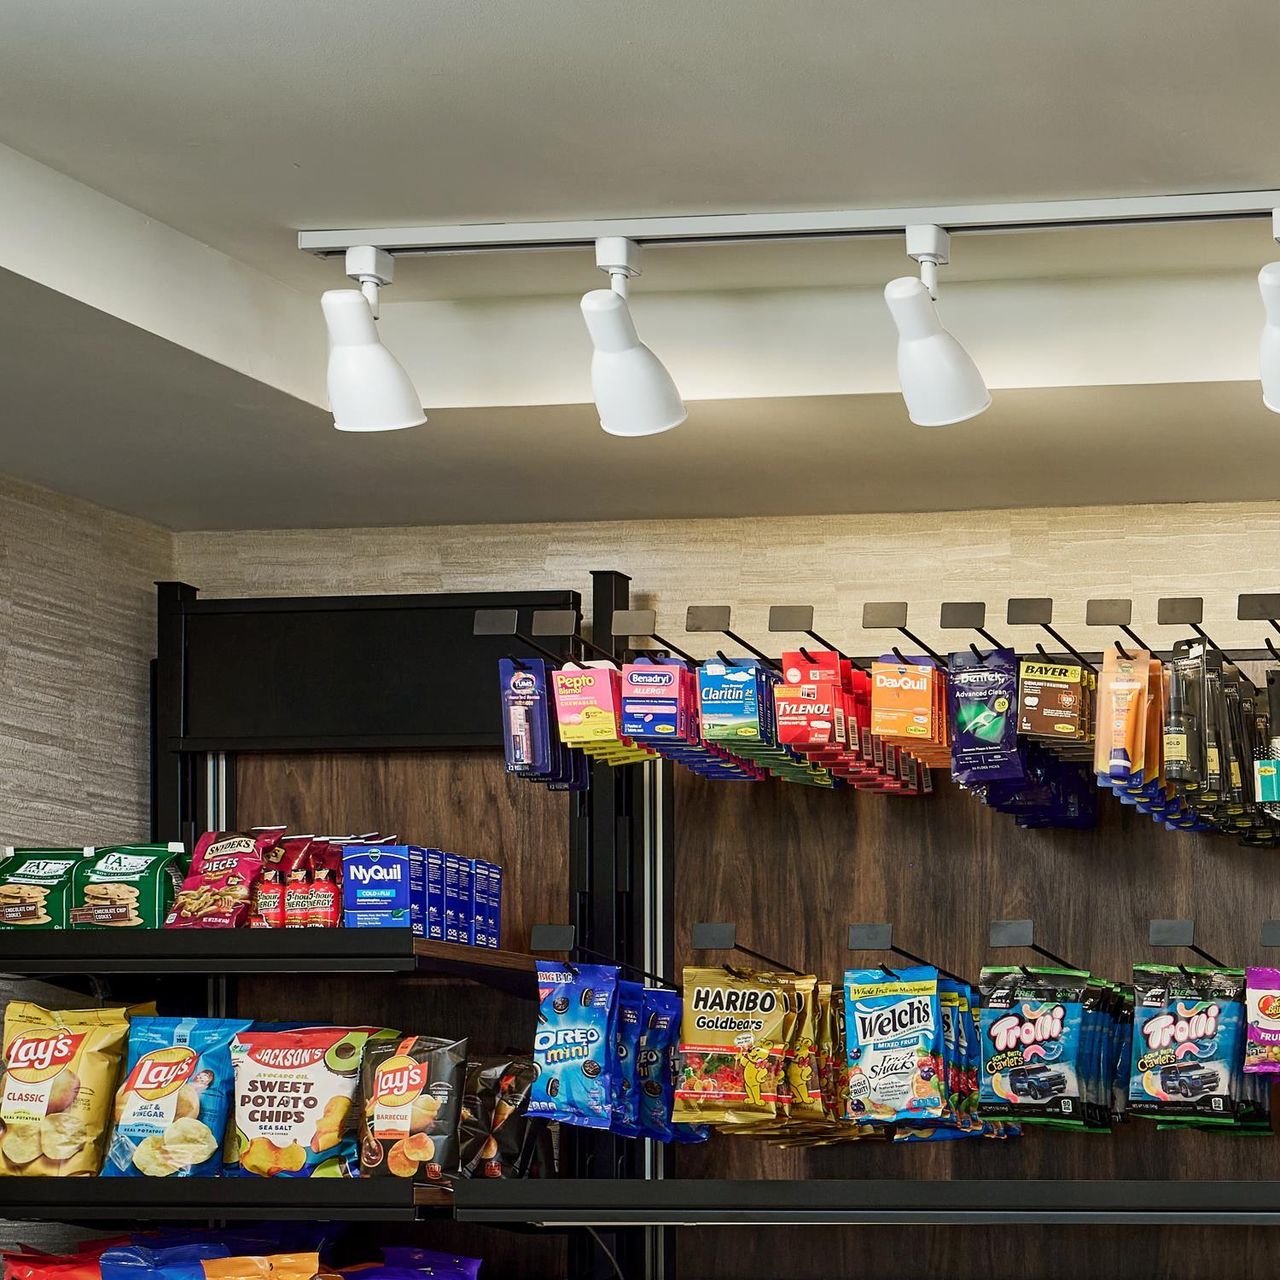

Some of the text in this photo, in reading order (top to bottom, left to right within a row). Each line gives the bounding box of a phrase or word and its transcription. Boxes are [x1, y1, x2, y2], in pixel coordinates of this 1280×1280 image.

[632, 674, 669, 683] Benadryl
[1025, 666, 1069, 677] BAYER
[557, 675, 594, 689] Pepto
[956, 689, 986, 698] Advanced
[778, 702, 830, 715] TYLENOL
[209, 839, 251, 855] SNYDER'S
[350, 865, 401, 884] NyQuil
[693, 989, 776, 1012] HARIBO
[696, 1016, 763, 1031] Goldbears
[859, 1001, 930, 1040] Welch's
[991, 1005, 1063, 1050] Trolli
[1146, 1004, 1219, 1050] Trolli
[535, 1029, 599, 1050] OREO
[878, 1041, 896, 1049] MIXED
[8, 1034, 71, 1069] Lay's
[256, 1049, 323, 1066] JACKSON'S
[546, 1045, 588, 1064] mini
[134, 1057, 190, 1089] Lay's
[378, 1066, 422, 1095] Lay's
[248, 1080, 314, 1093] SWEET
[7, 1092, 45, 1103] CLASSIC
[248, 1110, 305, 1123] CHIPS
